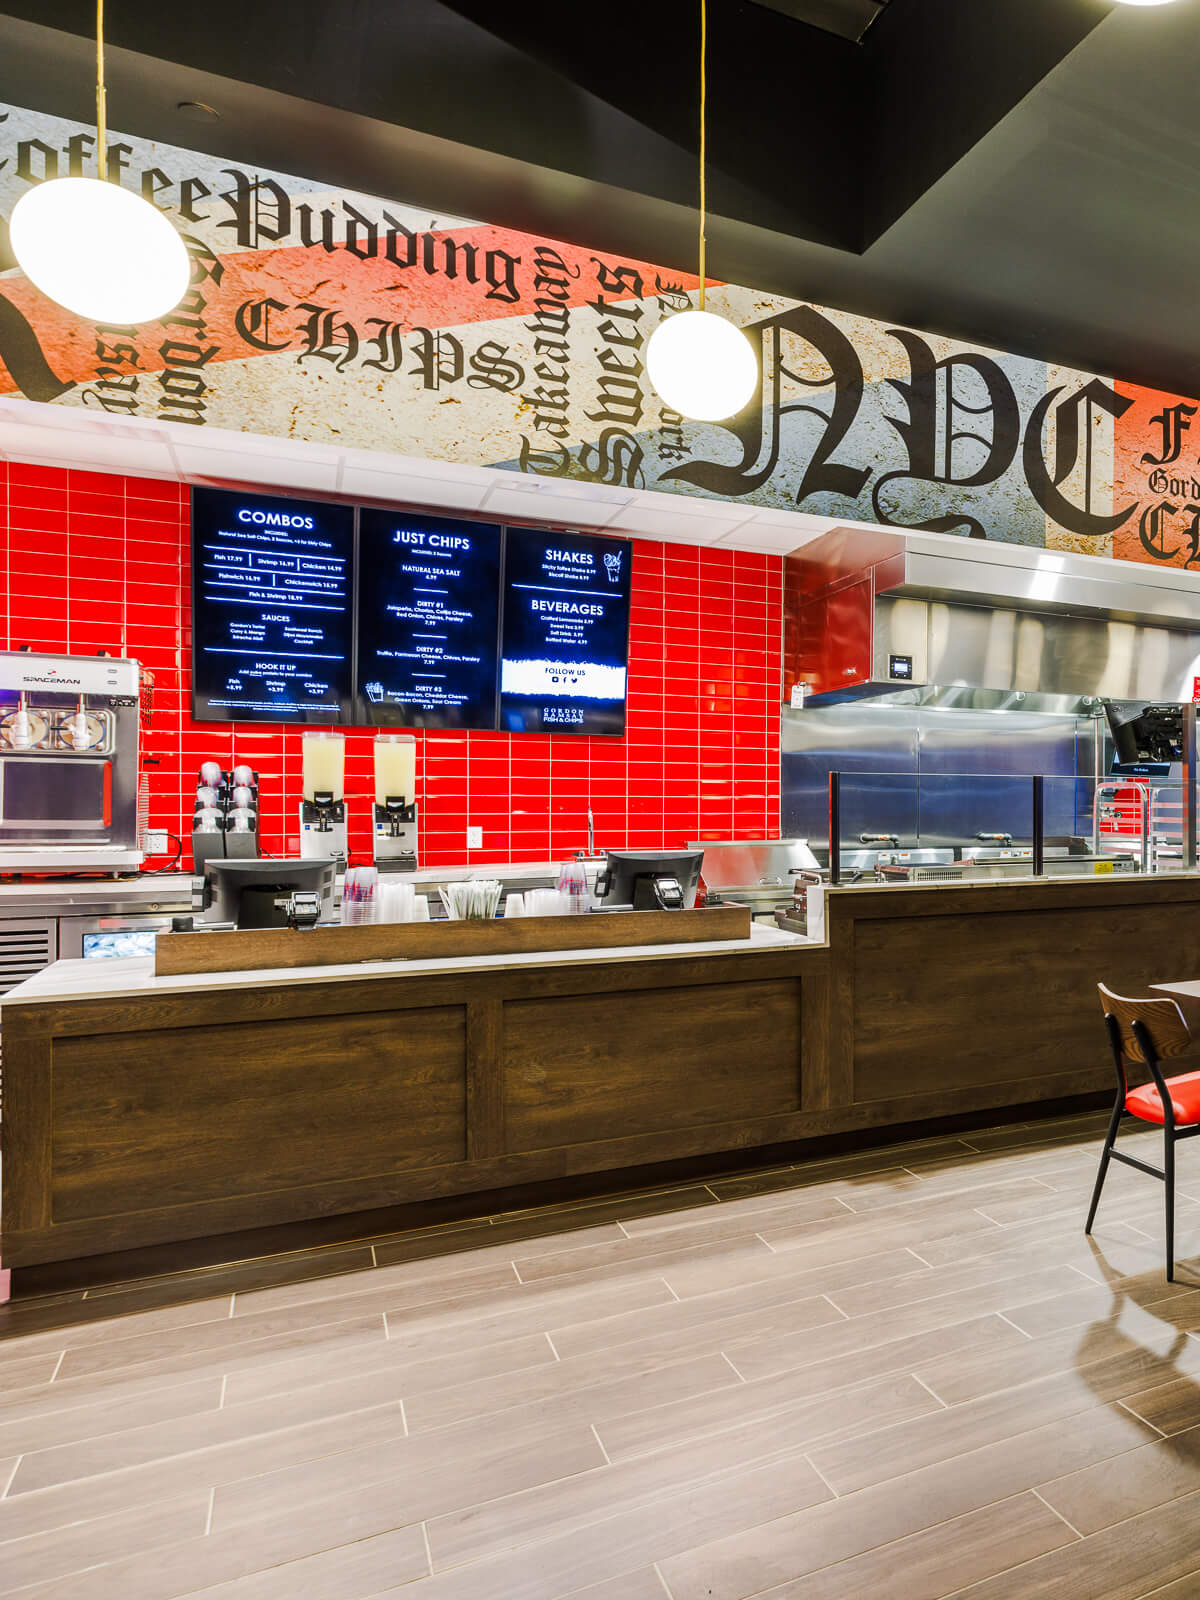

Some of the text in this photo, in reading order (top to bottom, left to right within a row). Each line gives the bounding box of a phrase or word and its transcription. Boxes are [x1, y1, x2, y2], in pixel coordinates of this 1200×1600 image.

[0, 113, 212, 223] offee
[216, 169, 523, 303] Pudding
[234, 297, 526, 392] CHIPS
[81, 325, 146, 416] say
[519, 245, 580, 477] Takeaway
[579, 256, 645, 489] Sweets
[657, 304, 1139, 539] NYC
[658, 407, 693, 461] ork
[238, 510, 314, 529] COMBOS
[393, 530, 470, 550] JUST CHIPS
[302, 562, 326, 571] Chicken
[545, 549, 594, 565] SHAKES
[402, 565, 431, 574] NATURAL
[445, 569, 461, 577] SALT
[417, 600, 435, 608] DIRTY
[531, 600, 604, 616] BEVERAGES
[255, 662, 279, 670] HOOK
[545, 667, 575, 675] FOLLOW
[23, 676, 81, 685] SPACEMAN
